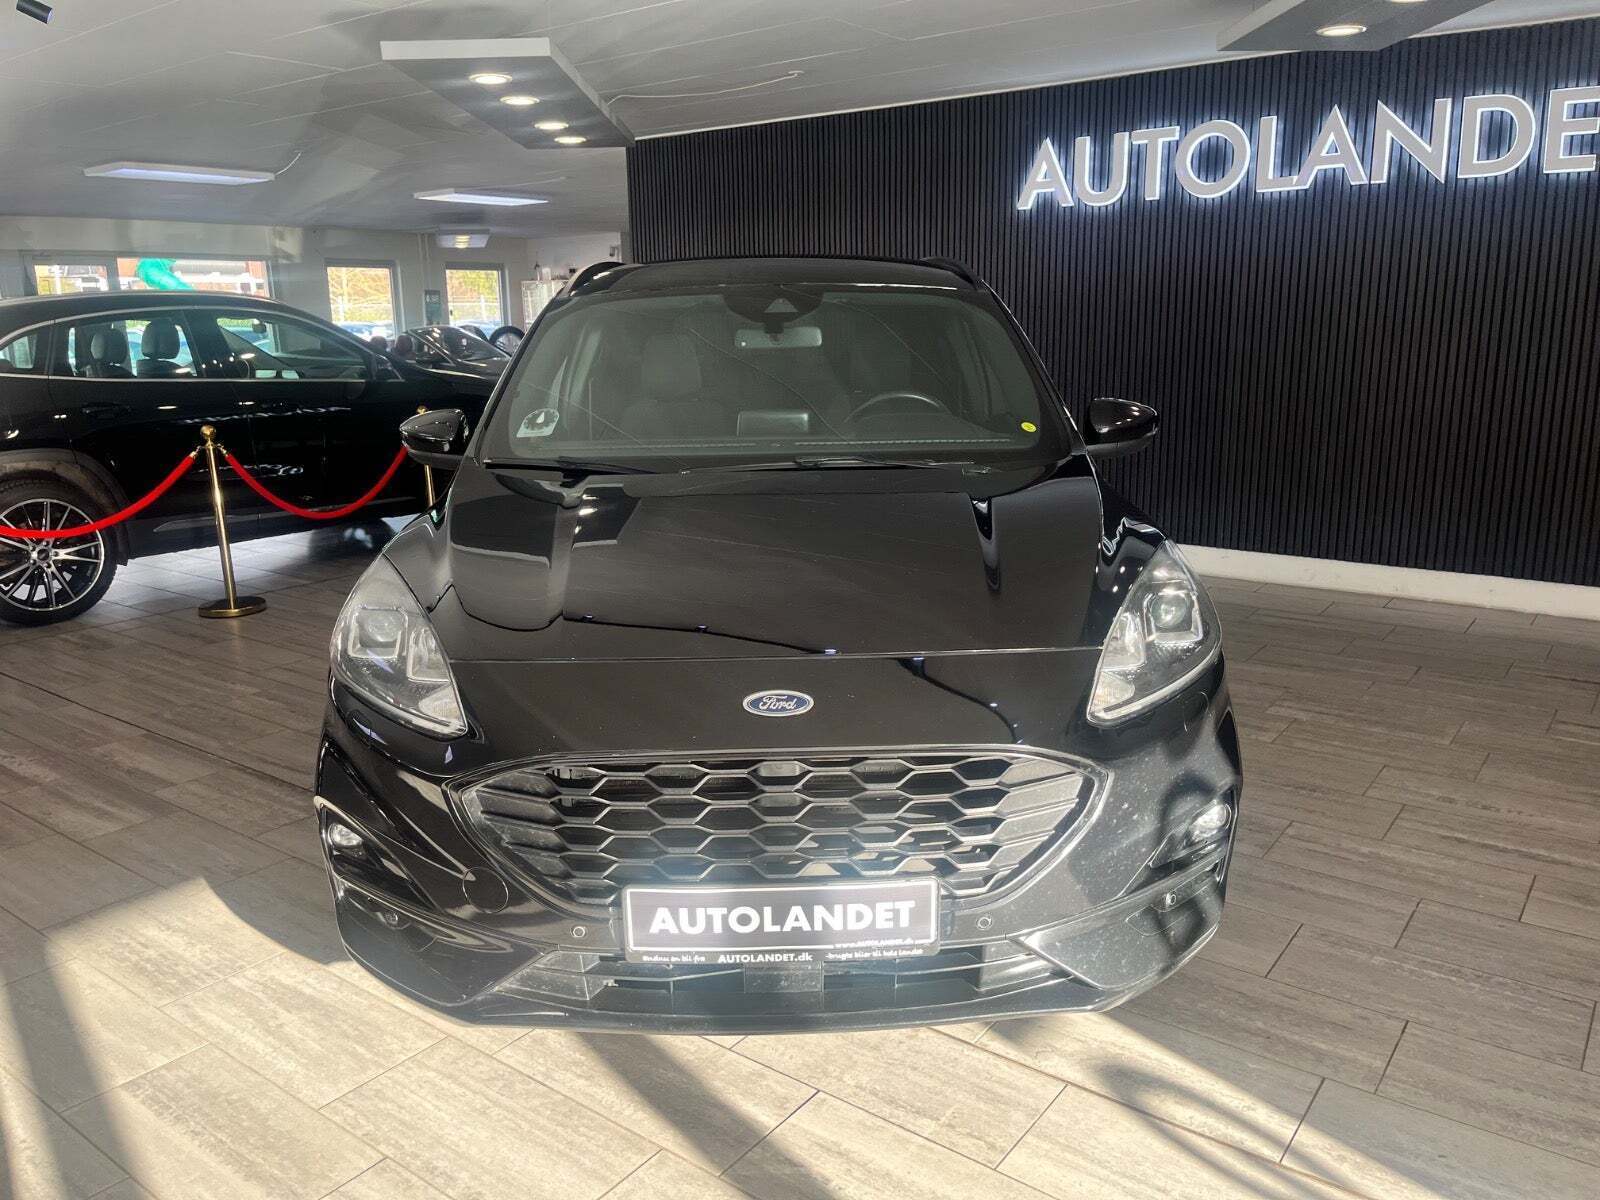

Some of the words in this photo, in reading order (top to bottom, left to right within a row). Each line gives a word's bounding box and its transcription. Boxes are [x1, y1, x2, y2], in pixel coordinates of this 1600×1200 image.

[1017, 86, 1600, 211] AUTOLANDE
[759, 695, 797, 710] Ford
[649, 900, 916, 935] AUTOLANDET
[718, 952, 814, 963] AUTOLANDET.dk
